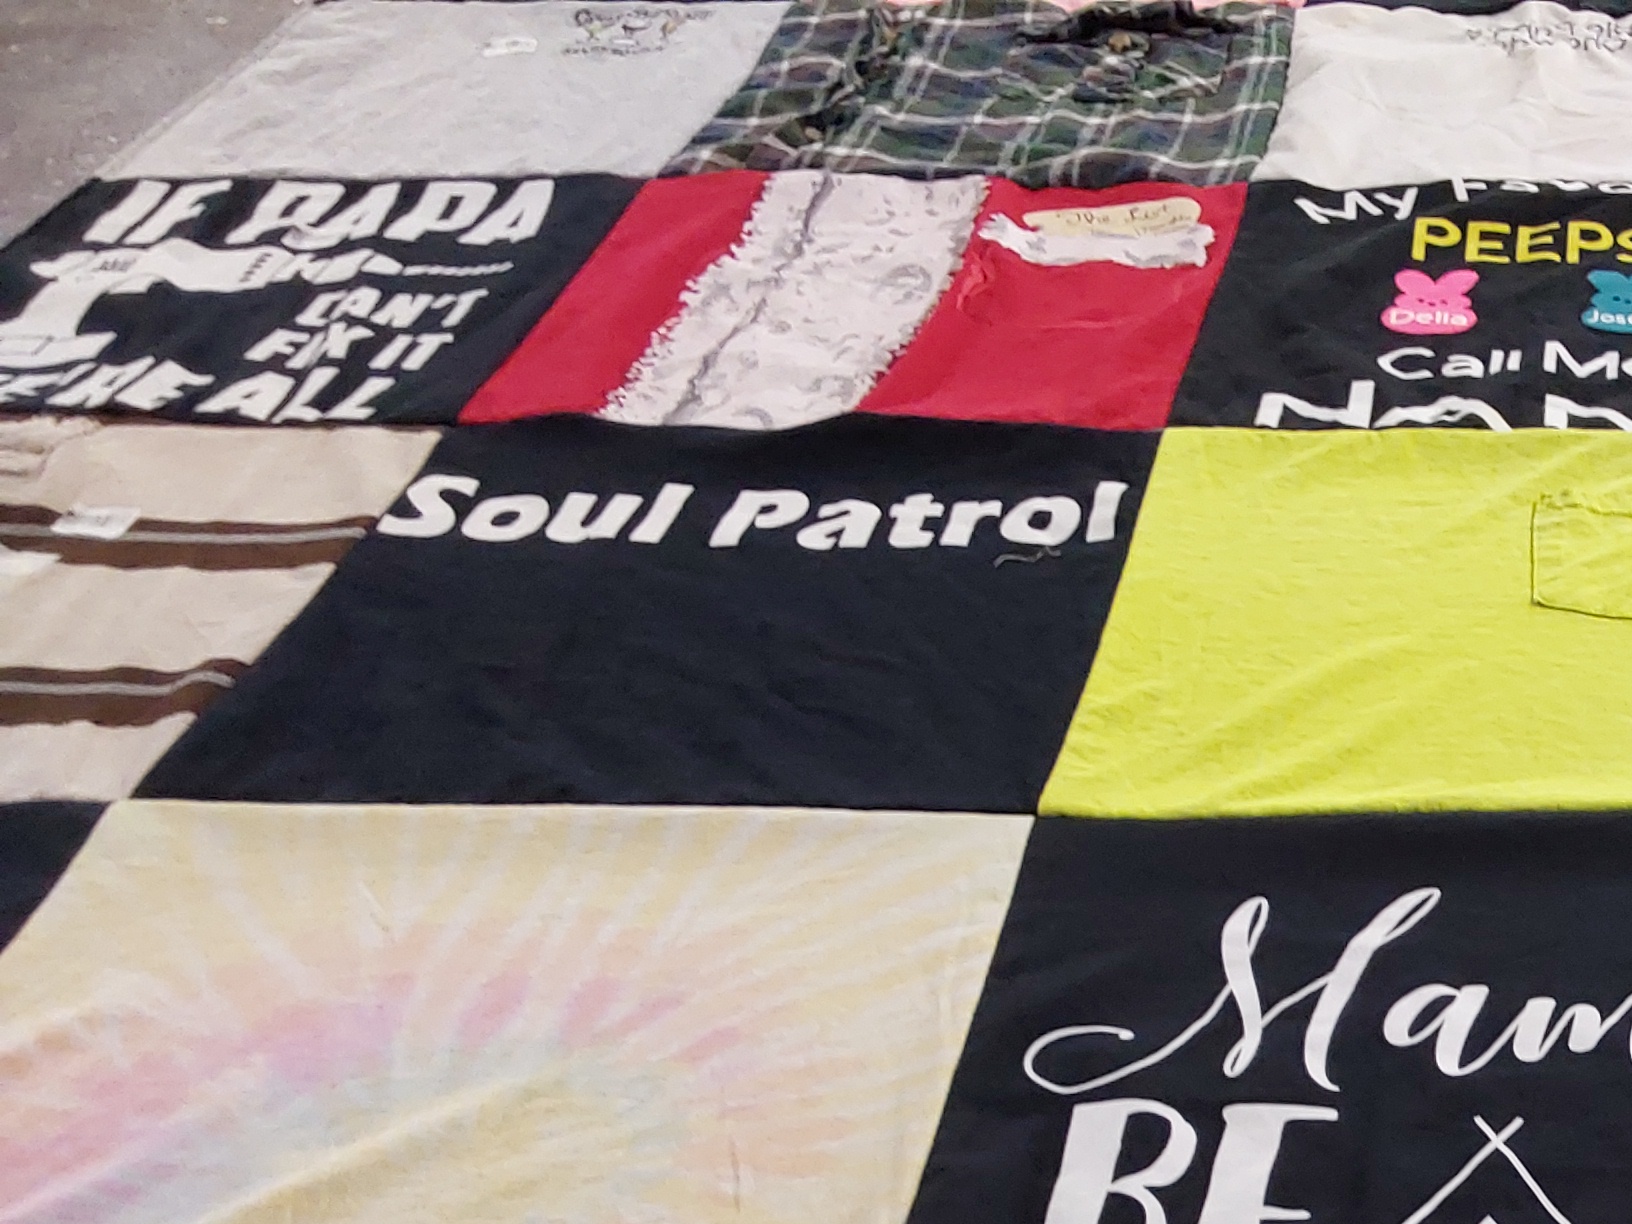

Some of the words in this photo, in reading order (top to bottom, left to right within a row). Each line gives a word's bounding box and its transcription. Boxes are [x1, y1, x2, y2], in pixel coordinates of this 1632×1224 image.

[83, 179, 233, 245] IF
[225, 179, 556, 250] PAPA
[1294, 189, 1419, 225] My
[295, 285, 490, 328] CAN'T
[243, 321, 376, 370] FIX
[367, 332, 455, 370] IT
[1377, 346, 1523, 380] Call
[0, 355, 216, 411] E'RE
[193, 366, 397, 424] ALL
[378, 474, 694, 546] Soul
[708, 479, 1129, 551] Patrol
